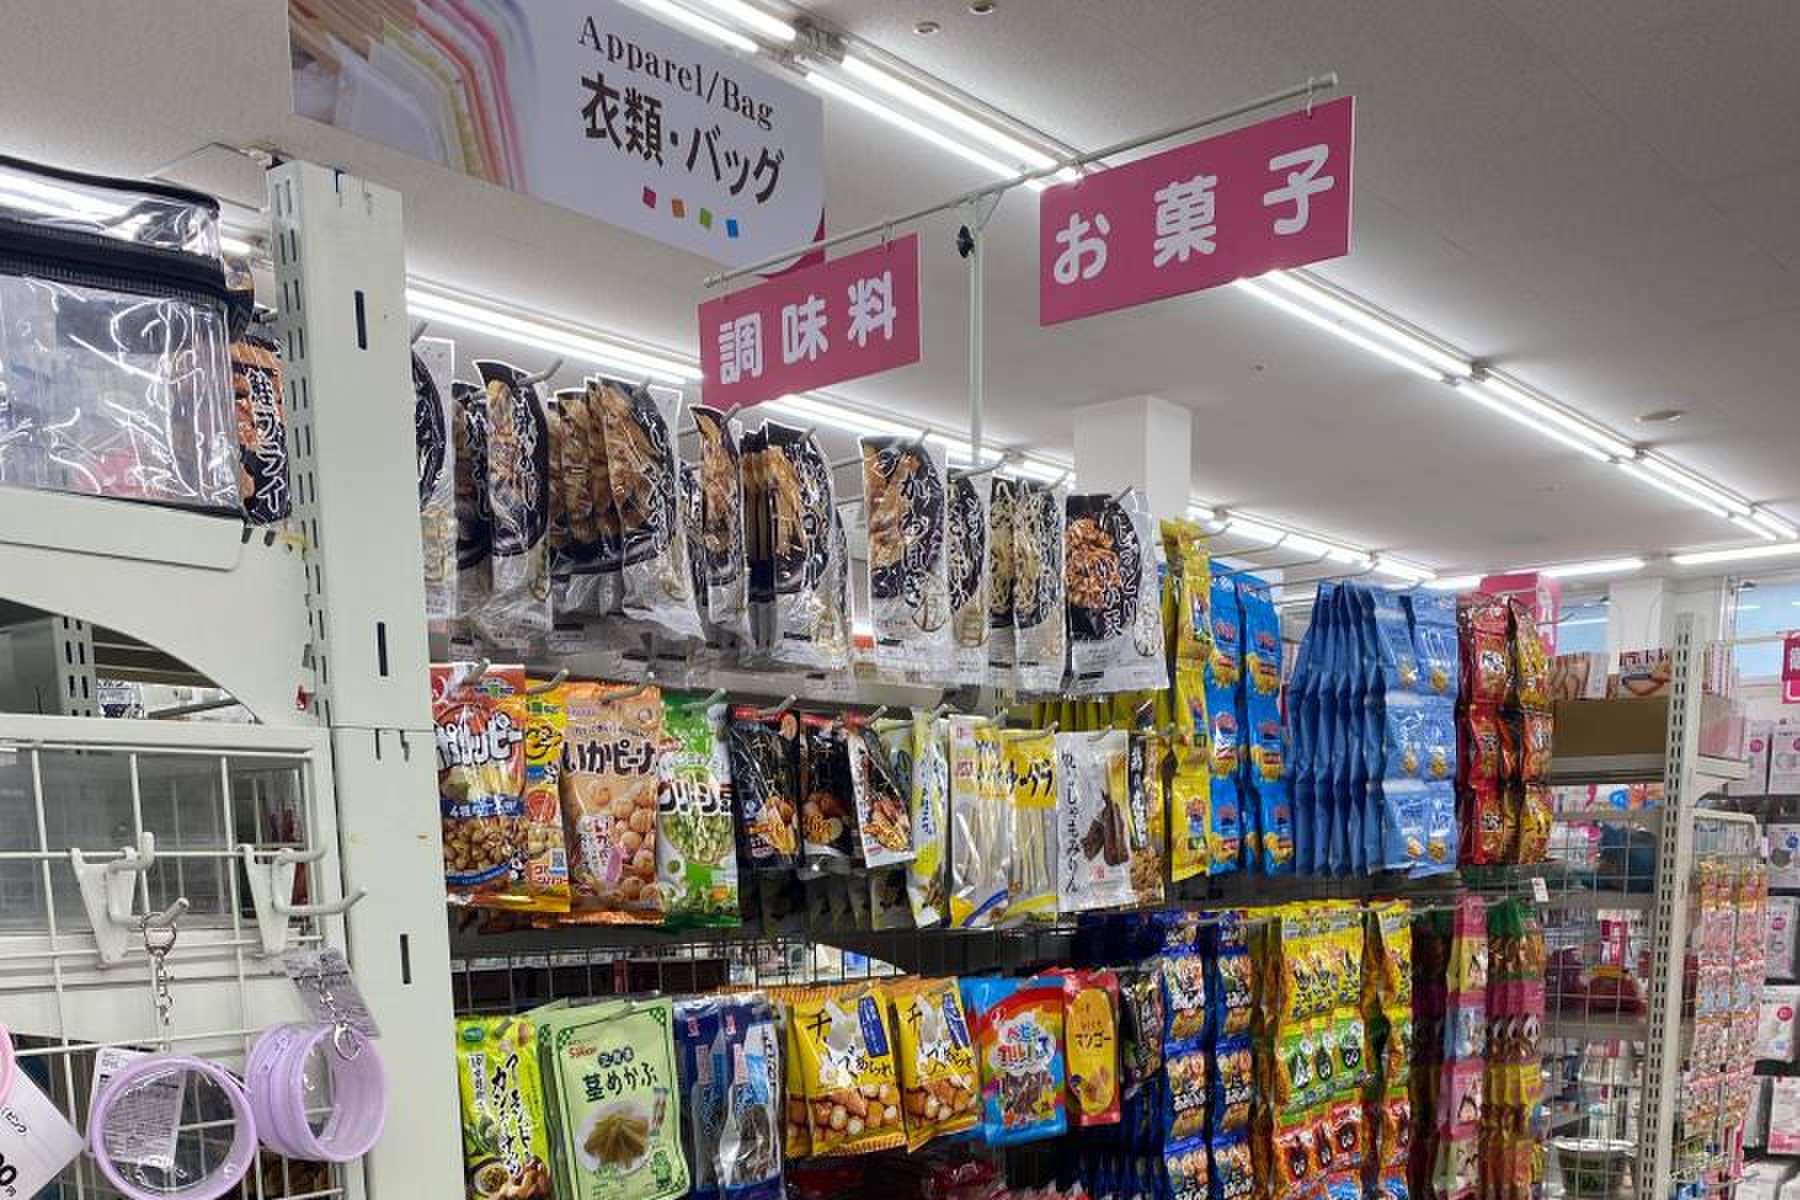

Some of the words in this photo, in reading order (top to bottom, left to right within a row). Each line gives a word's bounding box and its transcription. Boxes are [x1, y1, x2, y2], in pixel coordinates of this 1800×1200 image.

[577, 14, 775, 132] Apparel/Bag
[579, 72, 785, 206] 衣類・バッグ
[1052, 143, 1336, 286] お菓子
[718, 270, 898, 386] 調味料
[581, 1061, 659, 1103] 茎めかぶ
